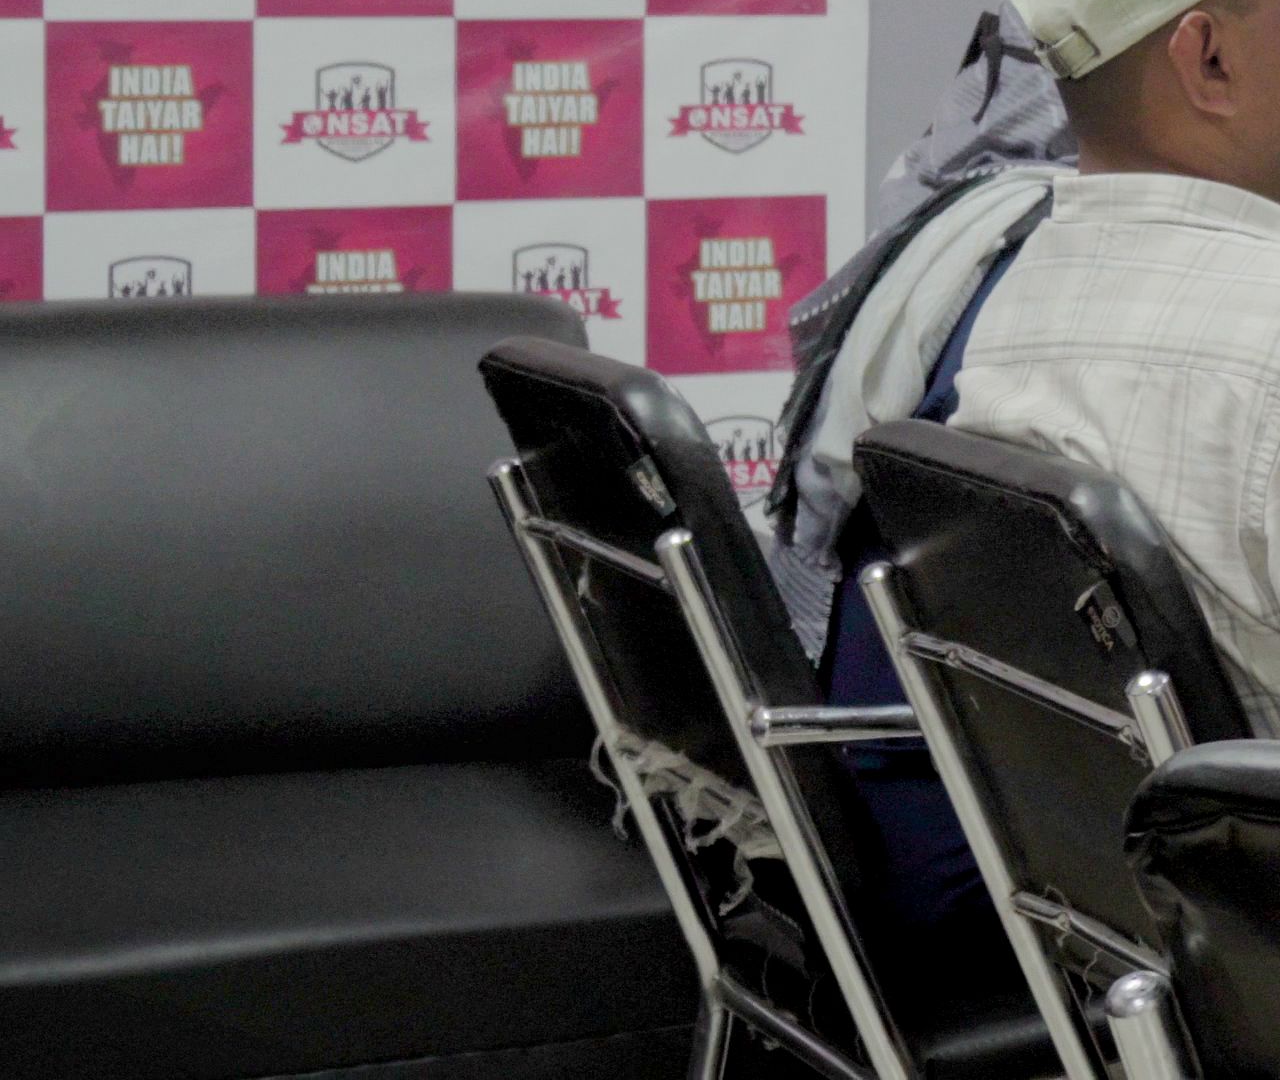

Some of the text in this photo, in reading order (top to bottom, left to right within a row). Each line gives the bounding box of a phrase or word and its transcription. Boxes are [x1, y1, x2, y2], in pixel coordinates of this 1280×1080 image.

[109, 65, 193, 98] INDIA
[513, 62, 590, 92] INDIA
[99, 99, 203, 132] TAIYAR
[505, 94, 598, 125] TAIYAR
[118, 131, 184, 165] HAI!
[522, 126, 581, 158] HAI!
[316, 249, 396, 282] INDIA
[700, 238, 774, 268] INDIA
[692, 269, 781, 301] TAIYAR
[709, 301, 766, 334] HAI!
